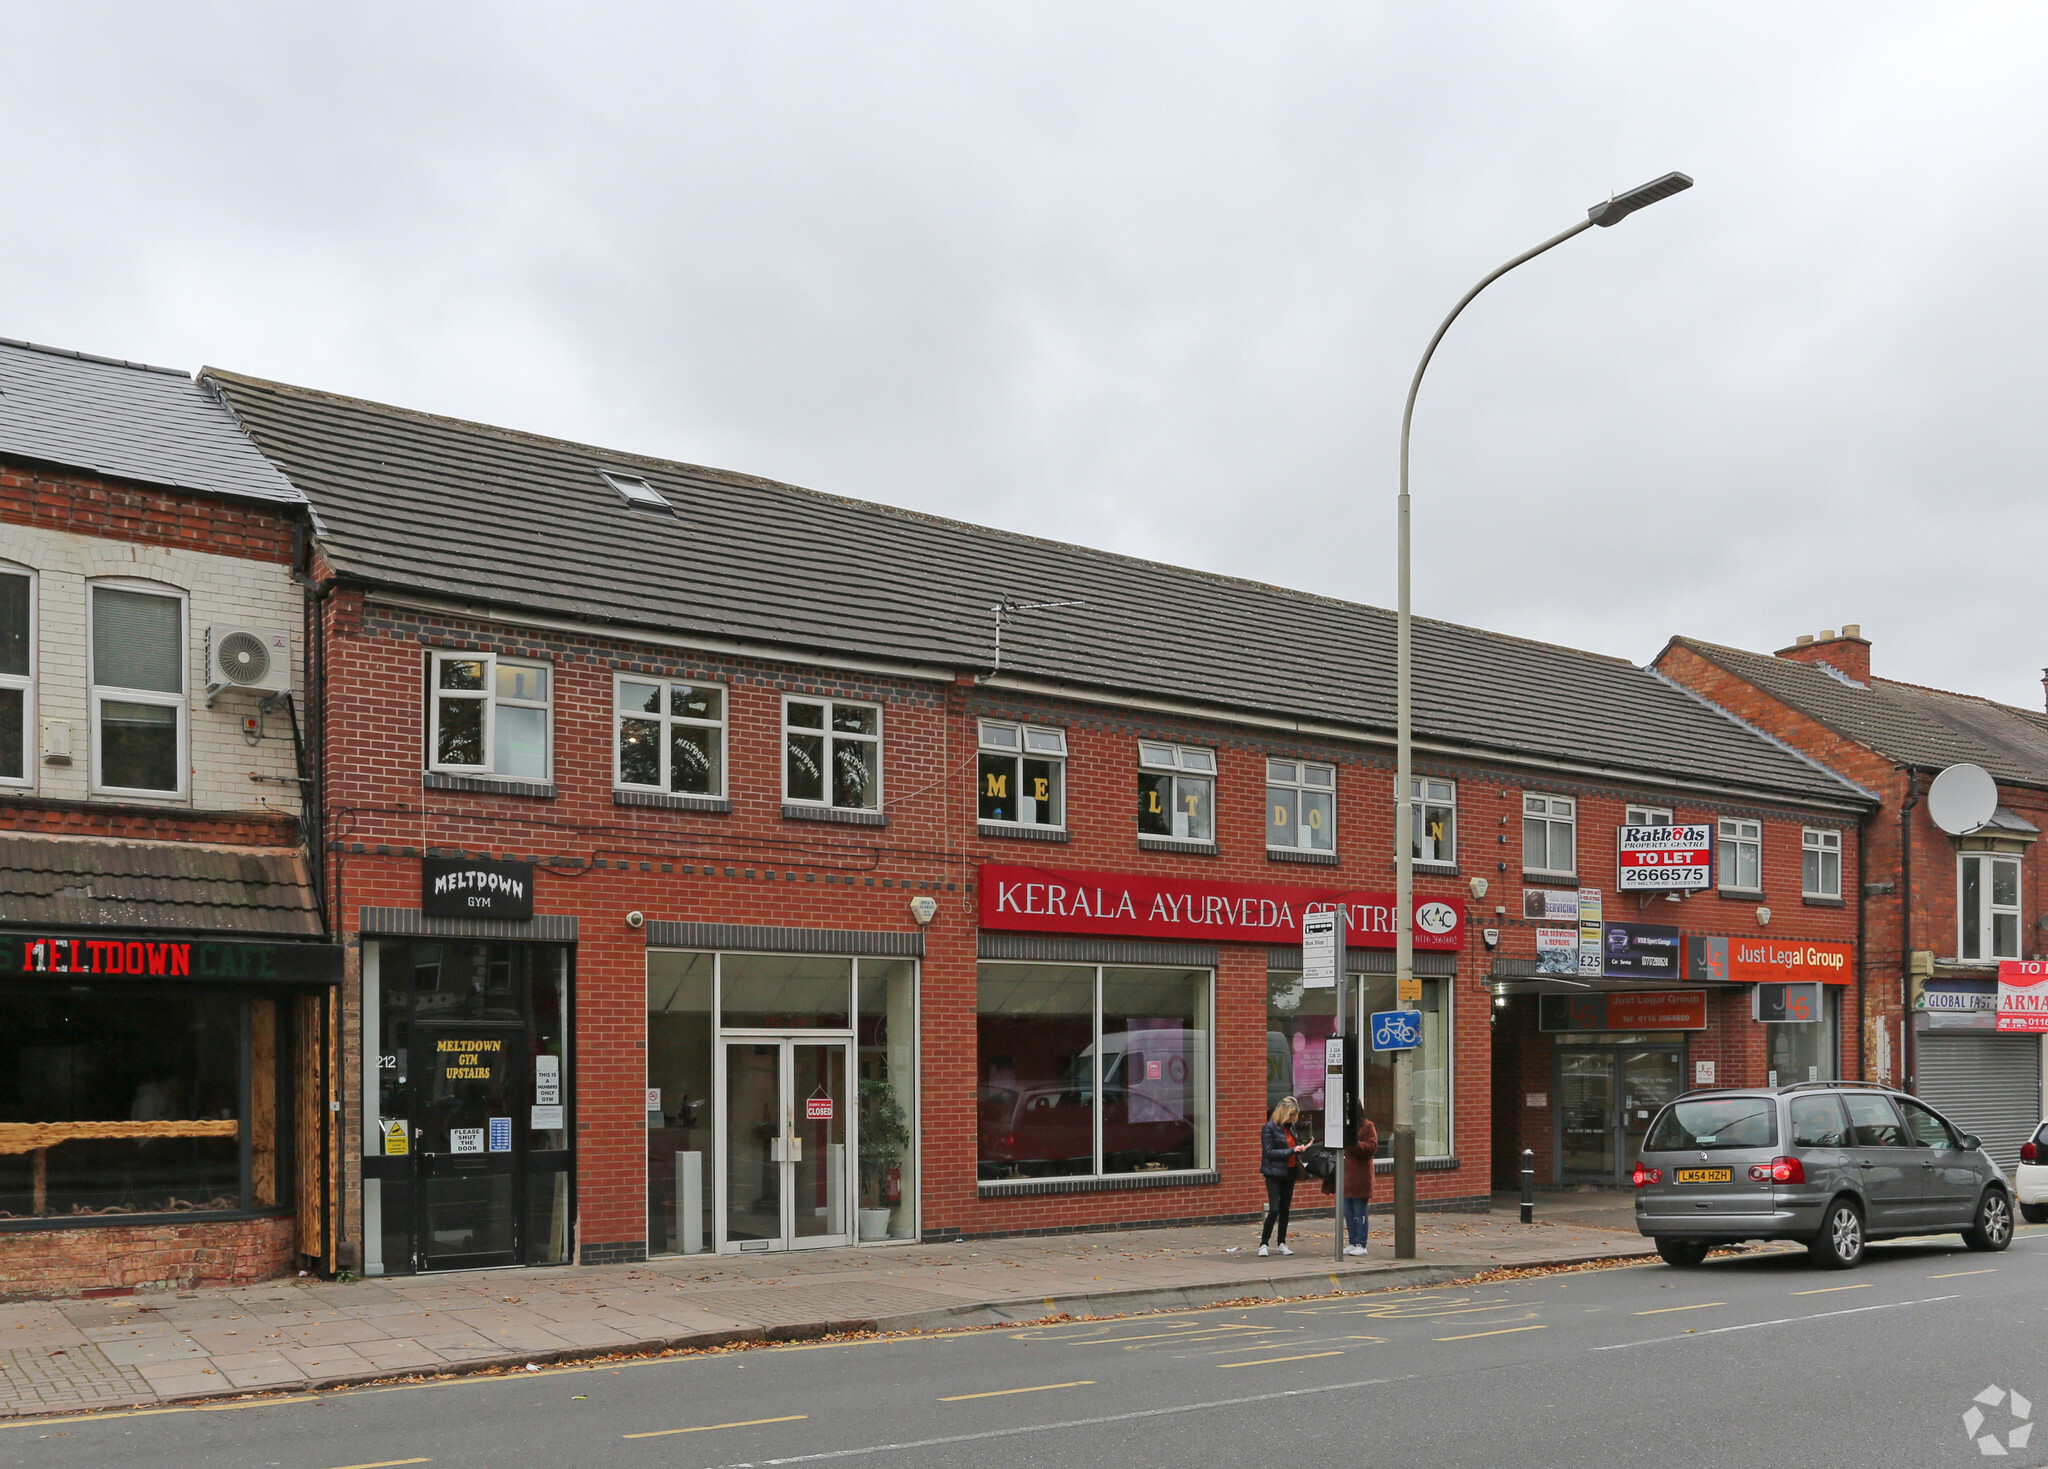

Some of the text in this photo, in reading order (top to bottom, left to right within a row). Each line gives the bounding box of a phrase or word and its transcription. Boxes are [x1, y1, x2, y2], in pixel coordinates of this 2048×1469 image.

[675, 738, 710, 771] MELTDOWN
[789, 744, 820, 780] MELTDOWN
[1625, 827, 1705, 842] Rathods
[1636, 852, 1694, 864] TO LET
[1626, 868, 1704, 881] 2666575
[434, 870, 524, 902] MELTDOWN
[467, 896, 492, 908] GYM
[996, 881, 1137, 920] KERALA
[1148, 892, 1296, 928] AYURVEDA
[1546, 902, 1577, 914] SERVICING
[1415, 934, 1430, 944] 0116
[23, 938, 190, 976] MELTDOWN
[200, 944, 278, 977] CAFE
[1580, 956, 1600, 967] £25
[1738, 944, 1766, 963] Just
[1770, 946, 1804, 968] Legal
[1806, 947, 1844, 970] Group
[2019, 962, 2040, 974] TO
[1612, 996, 1634, 1005] Just
[1637, 996, 1665, 1005] Legal
[1668, 995, 1700, 1004] Group
[1928, 994, 1965, 1008] GLOBAL
[1970, 996, 1992, 1008] FAST
[2002, 994, 2048, 1010] ARMA
[436, 1040, 502, 1052] MELTDOWN
[376, 1056, 396, 1068] 212
[458, 1054, 478, 1065] GYM
[446, 1067, 490, 1078] UPSTAIRS
[1708, 1171, 1728, 1180] HZH
[1284, 1296, 1545, 1326] BUS
[1009, 1320, 1389, 1359] STOP
